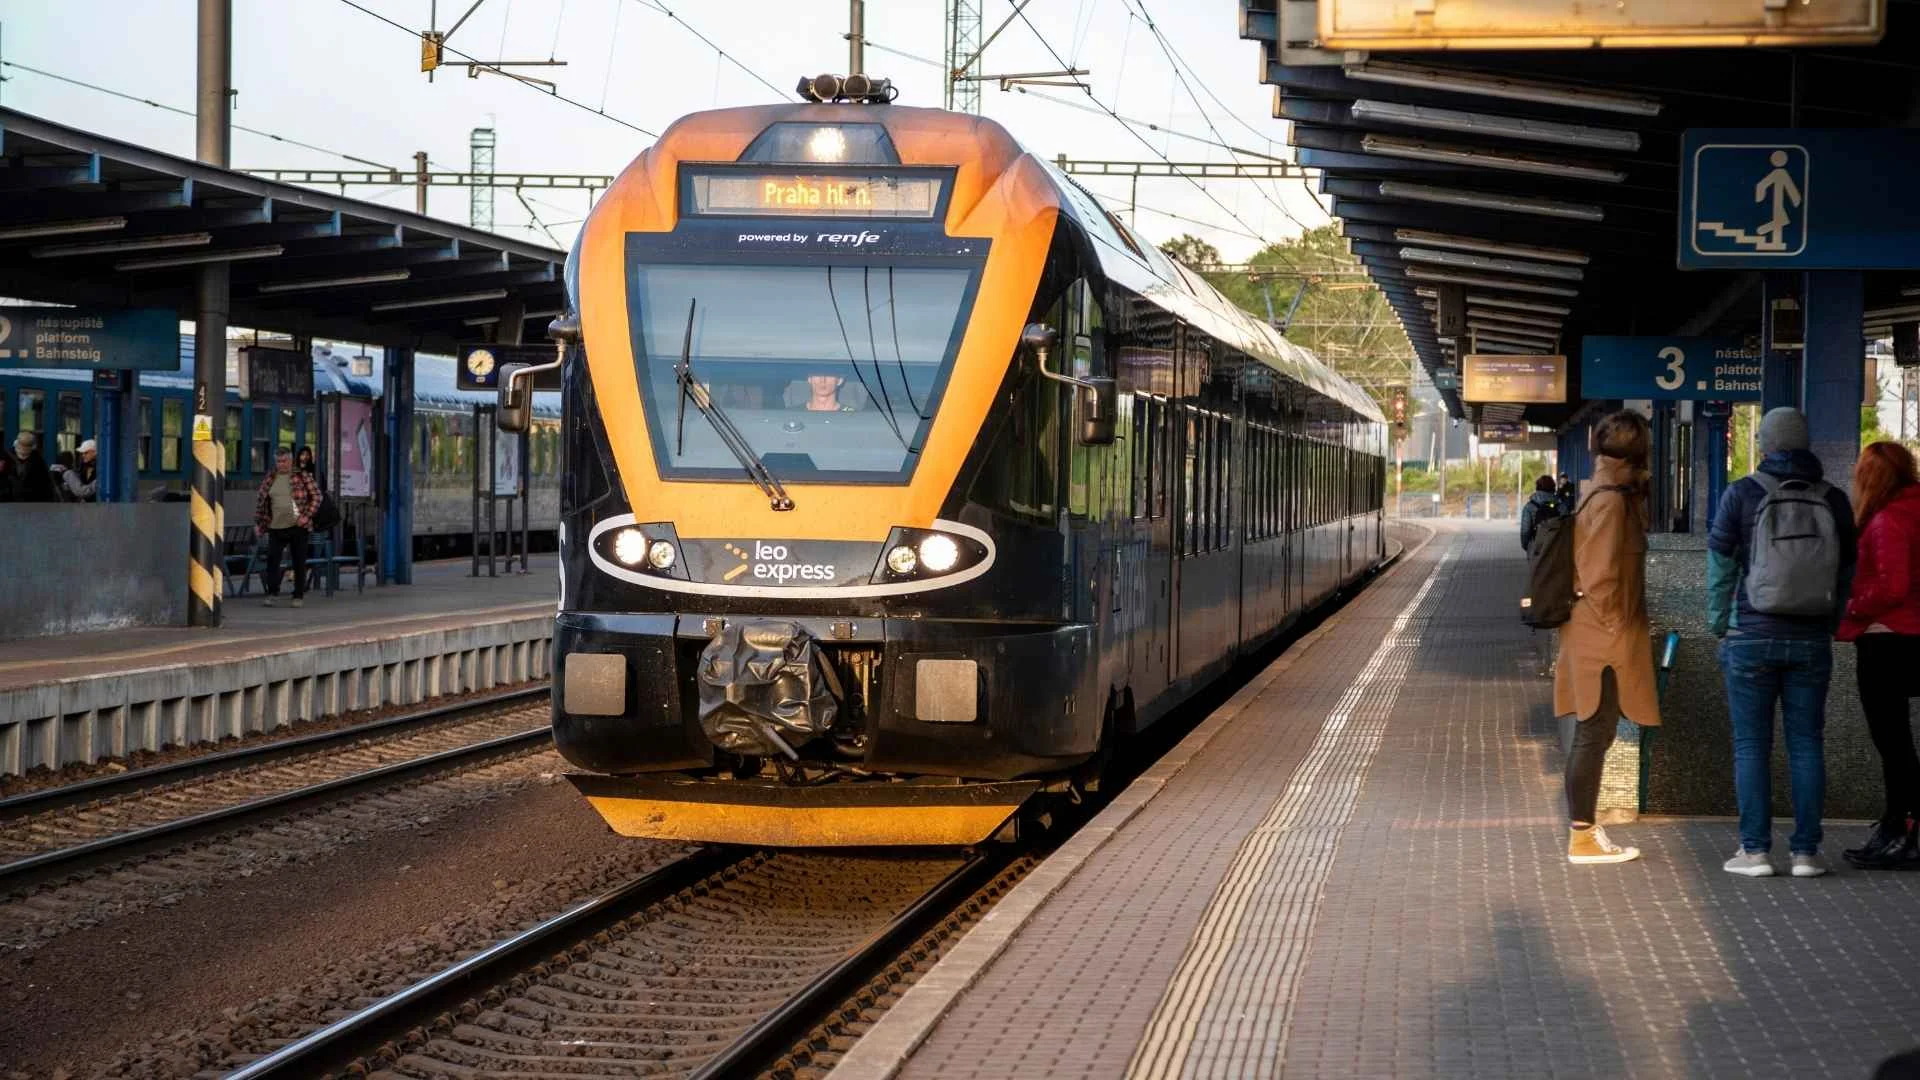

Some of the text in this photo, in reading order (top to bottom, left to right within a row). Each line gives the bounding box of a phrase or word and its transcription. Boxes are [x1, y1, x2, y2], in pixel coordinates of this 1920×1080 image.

[765, 182, 872, 205] Praha hl. n.
[738, 230, 880, 247] powered by renfe
[36, 331, 90, 344] platform
[36, 346, 101, 362] Bahnsteig
[1656, 346, 1707, 390] 3.
[755, 540, 788, 560] leo
[753, 563, 835, 584] express
